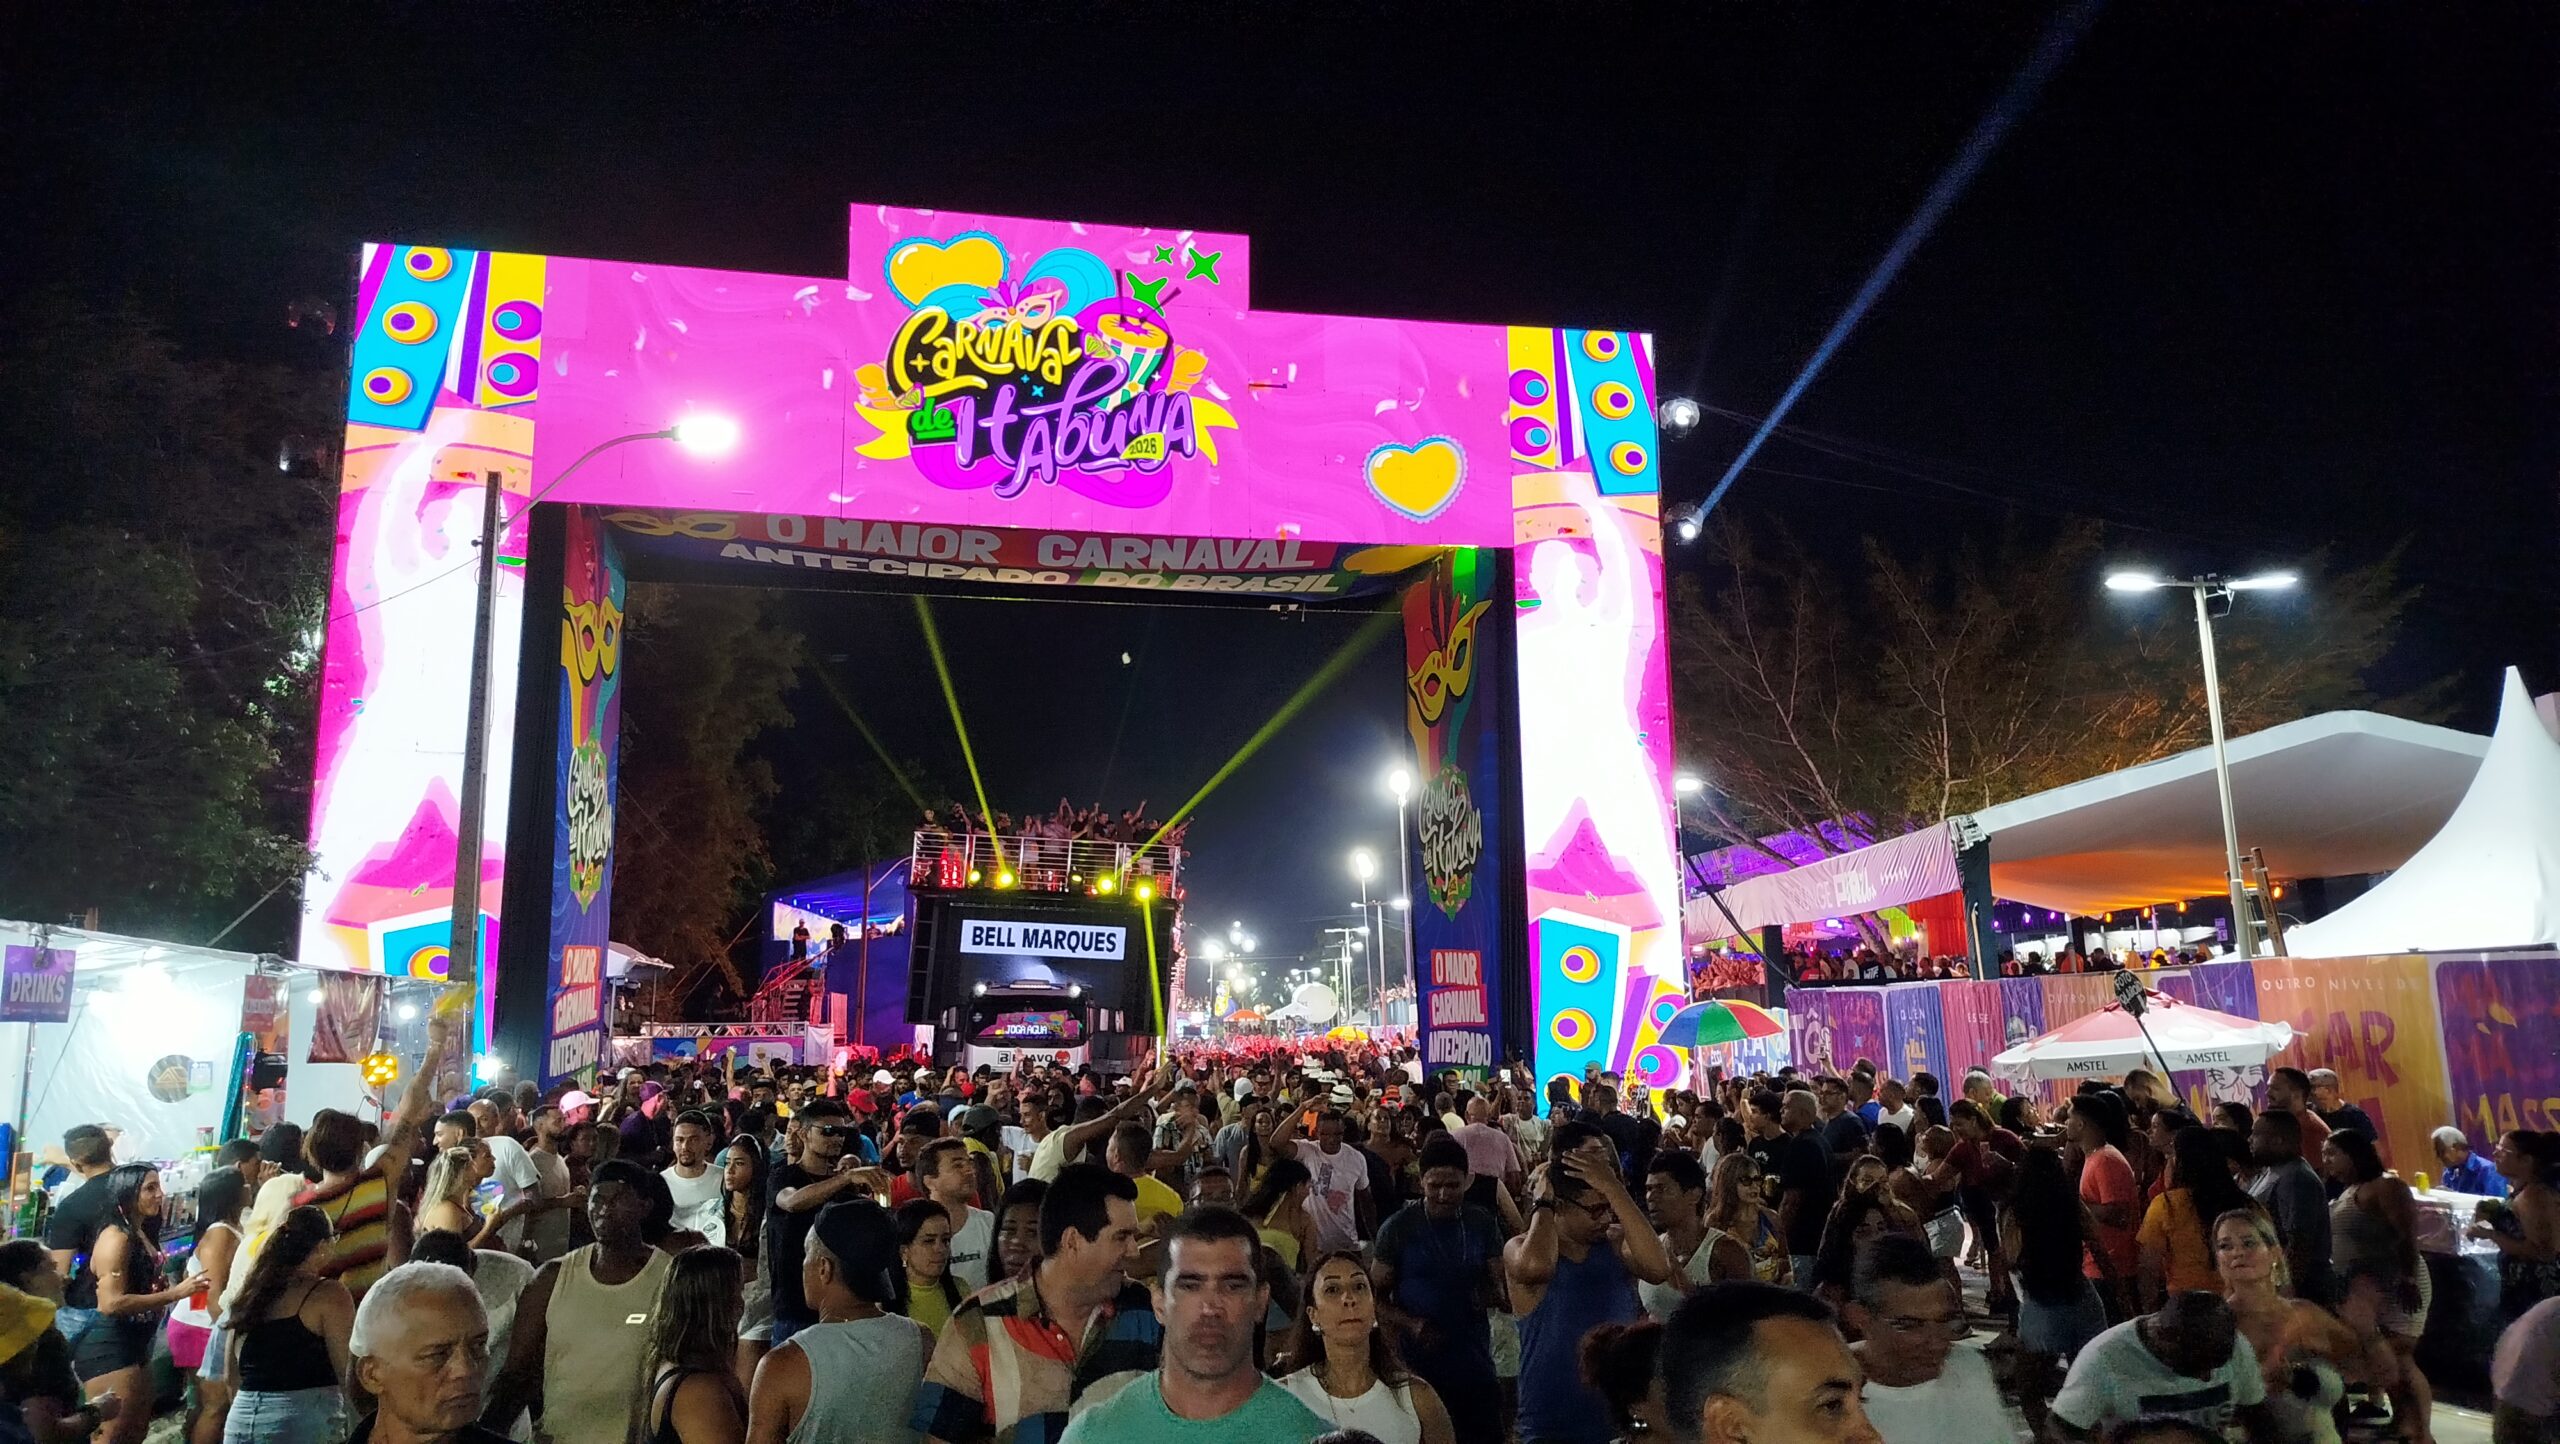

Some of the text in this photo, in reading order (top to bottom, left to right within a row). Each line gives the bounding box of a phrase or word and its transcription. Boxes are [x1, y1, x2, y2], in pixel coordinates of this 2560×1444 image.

[912, 397, 956, 438] de
[1129, 437, 1157, 455] 2026
[766, 515, 1315, 571] O MAIOR CARNAVAL
[720, 543, 1340, 593] ANTECIPADO DO BRASIL
[972, 926, 1117, 954] BELL MARQUES
[1435, 952, 1478, 987] O MAIOR
[2114, 972, 2132, 991] FOTO
[2262, 976, 2316, 992] OUTRO
[10, 971, 66, 1003] DRINKS
[555, 986, 598, 1034] CARNAVAL
[1431, 989, 1485, 1026] CARNAVAL
[1967, 1012, 1989, 1024] ESSE
[1005, 1025, 1026, 1035] JOGA
[549, 1029, 600, 1077] ANTECIPADO
[1429, 1030, 1492, 1067] ANTECIPADO
[2186, 1051, 2231, 1065] AMSTEL
[2066, 1060, 2109, 1073] AMSTEL
[950, 1251, 981, 1264] olcci
